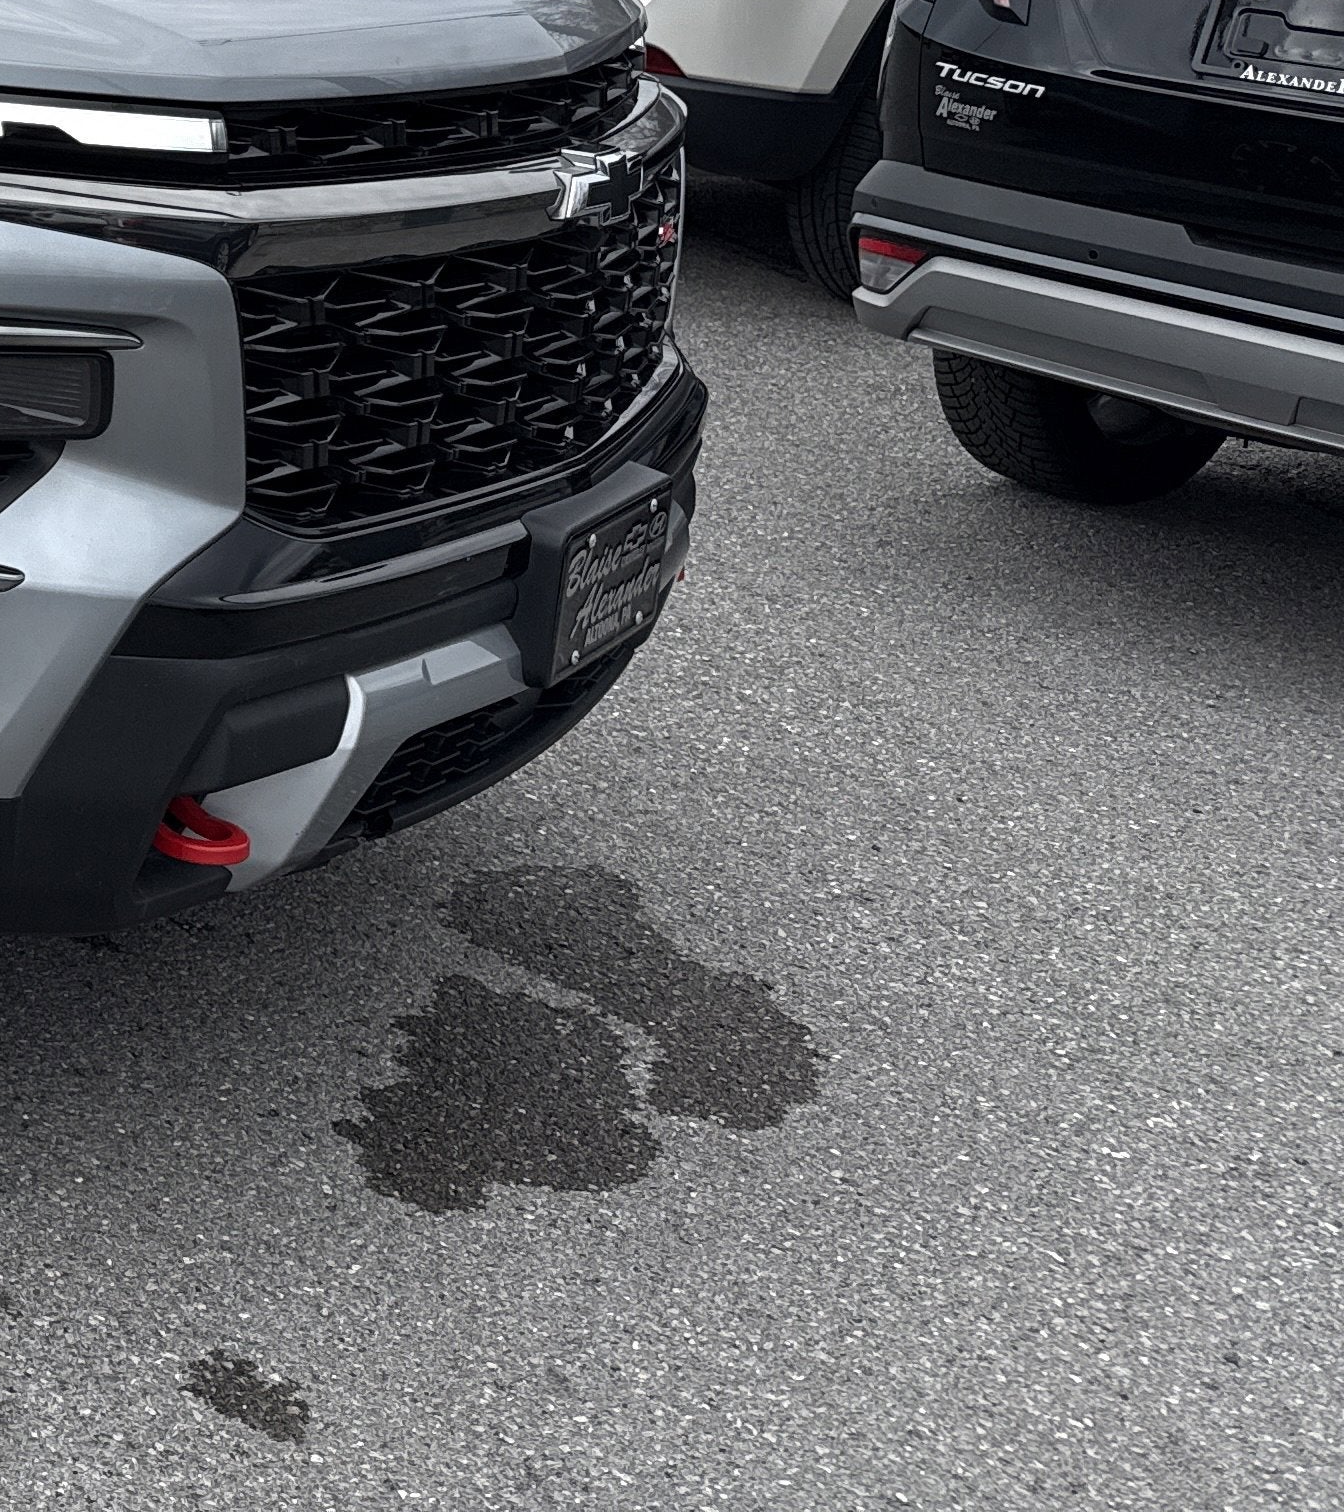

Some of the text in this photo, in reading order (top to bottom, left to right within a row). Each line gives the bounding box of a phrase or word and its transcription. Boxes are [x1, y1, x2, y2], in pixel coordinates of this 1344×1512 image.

[935, 96, 998, 121] Alexander
[566, 543, 623, 597] Blaise
[570, 555, 661, 639] Alexander
